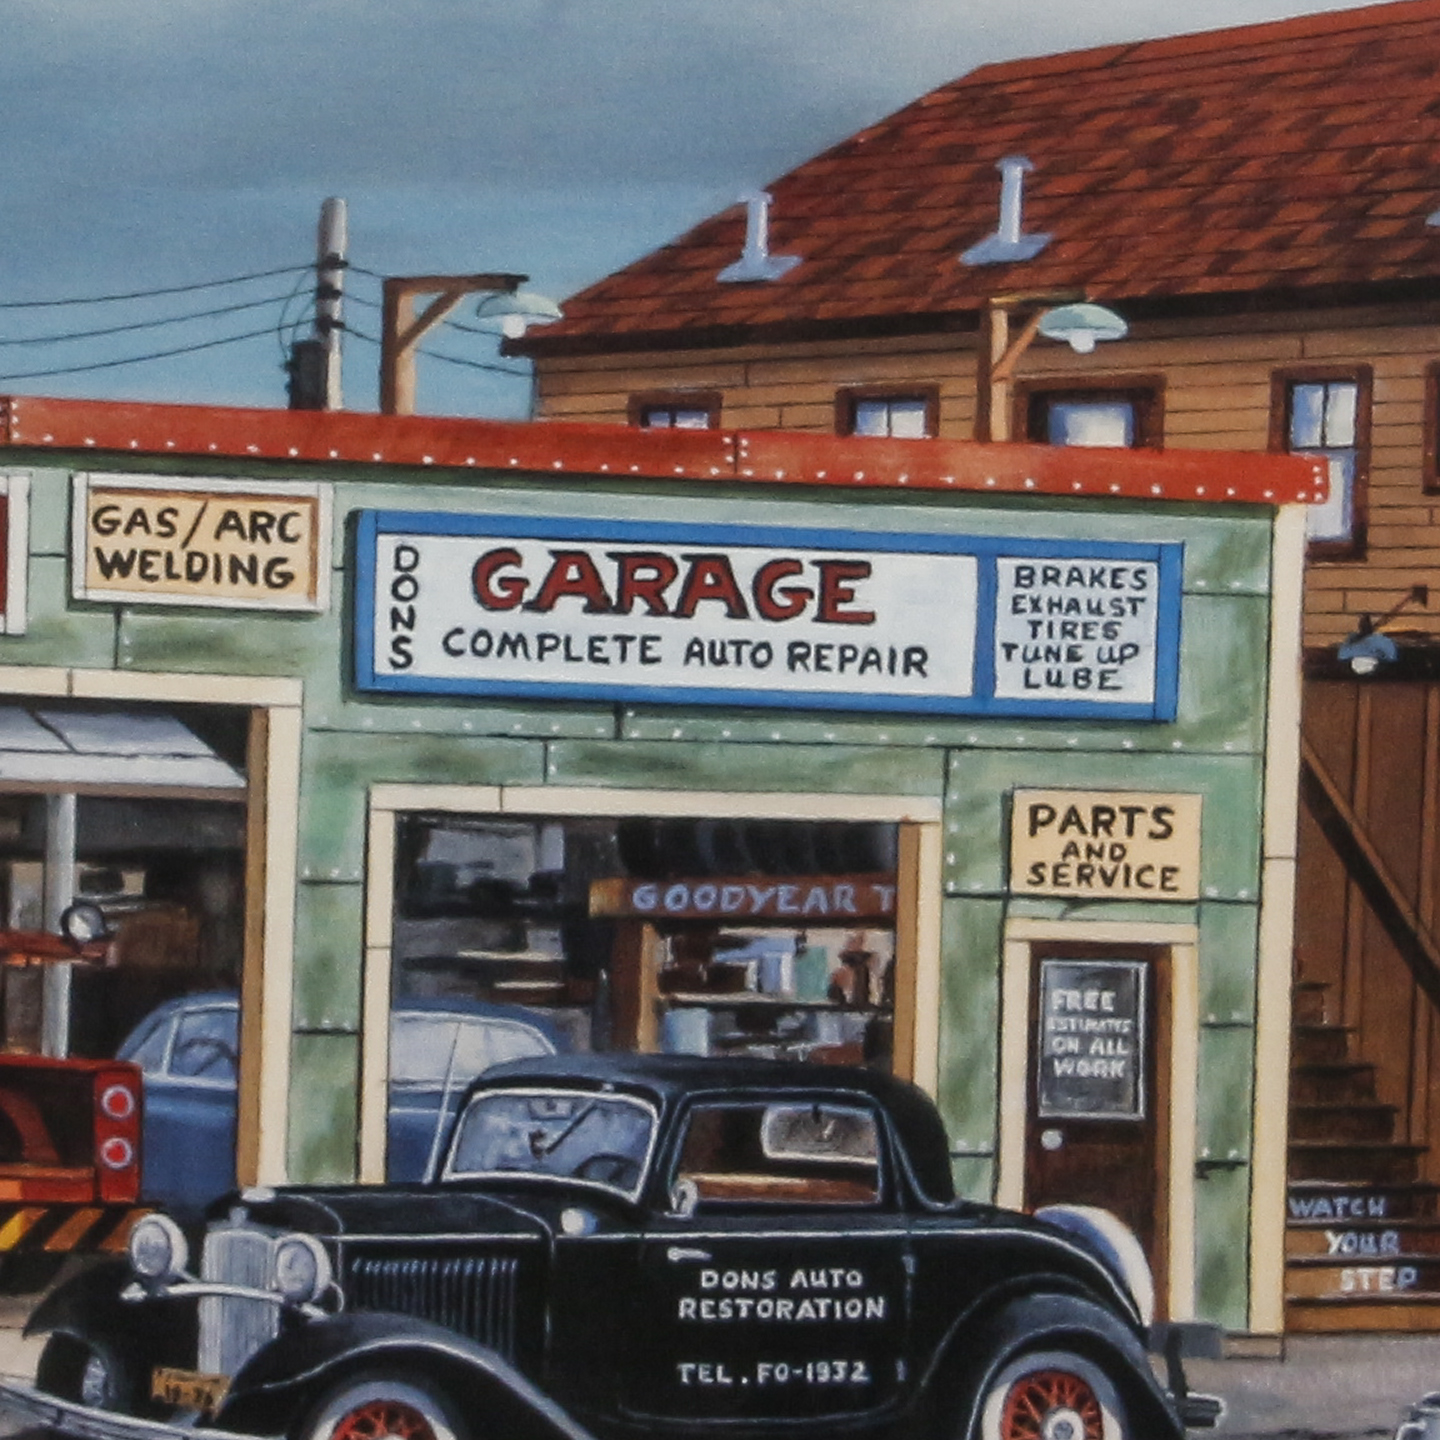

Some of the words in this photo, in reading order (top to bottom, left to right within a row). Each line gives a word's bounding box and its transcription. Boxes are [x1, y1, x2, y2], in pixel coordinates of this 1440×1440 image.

[94, 548, 296, 588] WELDING
[1014, 565, 1148, 591] BRAKES
[471, 547, 878, 626] GARAGE
[1011, 594, 1147, 617] EXHAUST
[1027, 619, 1122, 640] TIRES
[442, 626, 662, 666] COMPLETE
[682, 637, 774, 669] AUTO
[786, 641, 929, 679] REPAIR
[1001, 642, 1085, 664] TUNE
[1096, 642, 1140, 665] UP
[1024, 666, 1123, 691] LUBE
[1028, 804, 1175, 840] PARTS
[1061, 841, 1128, 864] AND
[1027, 862, 1181, 893] SERVICE
[630, 882, 857, 914] GOODYEAR
[1050, 988, 1117, 1012] FREE
[1051, 1036, 1080, 1055] ON
[1088, 1037, 1129, 1056] ALL
[1053, 1057, 1126, 1078] WORK
[1288, 1196, 1386, 1218] WATCH
[1324, 1231, 1400, 1255] YOUR
[700, 1269, 776, 1290] DONS
[789, 1268, 863, 1289] AUTO
[1339, 1266, 1418, 1291] STEP
[678, 1295, 886, 1319] RESTORATION
